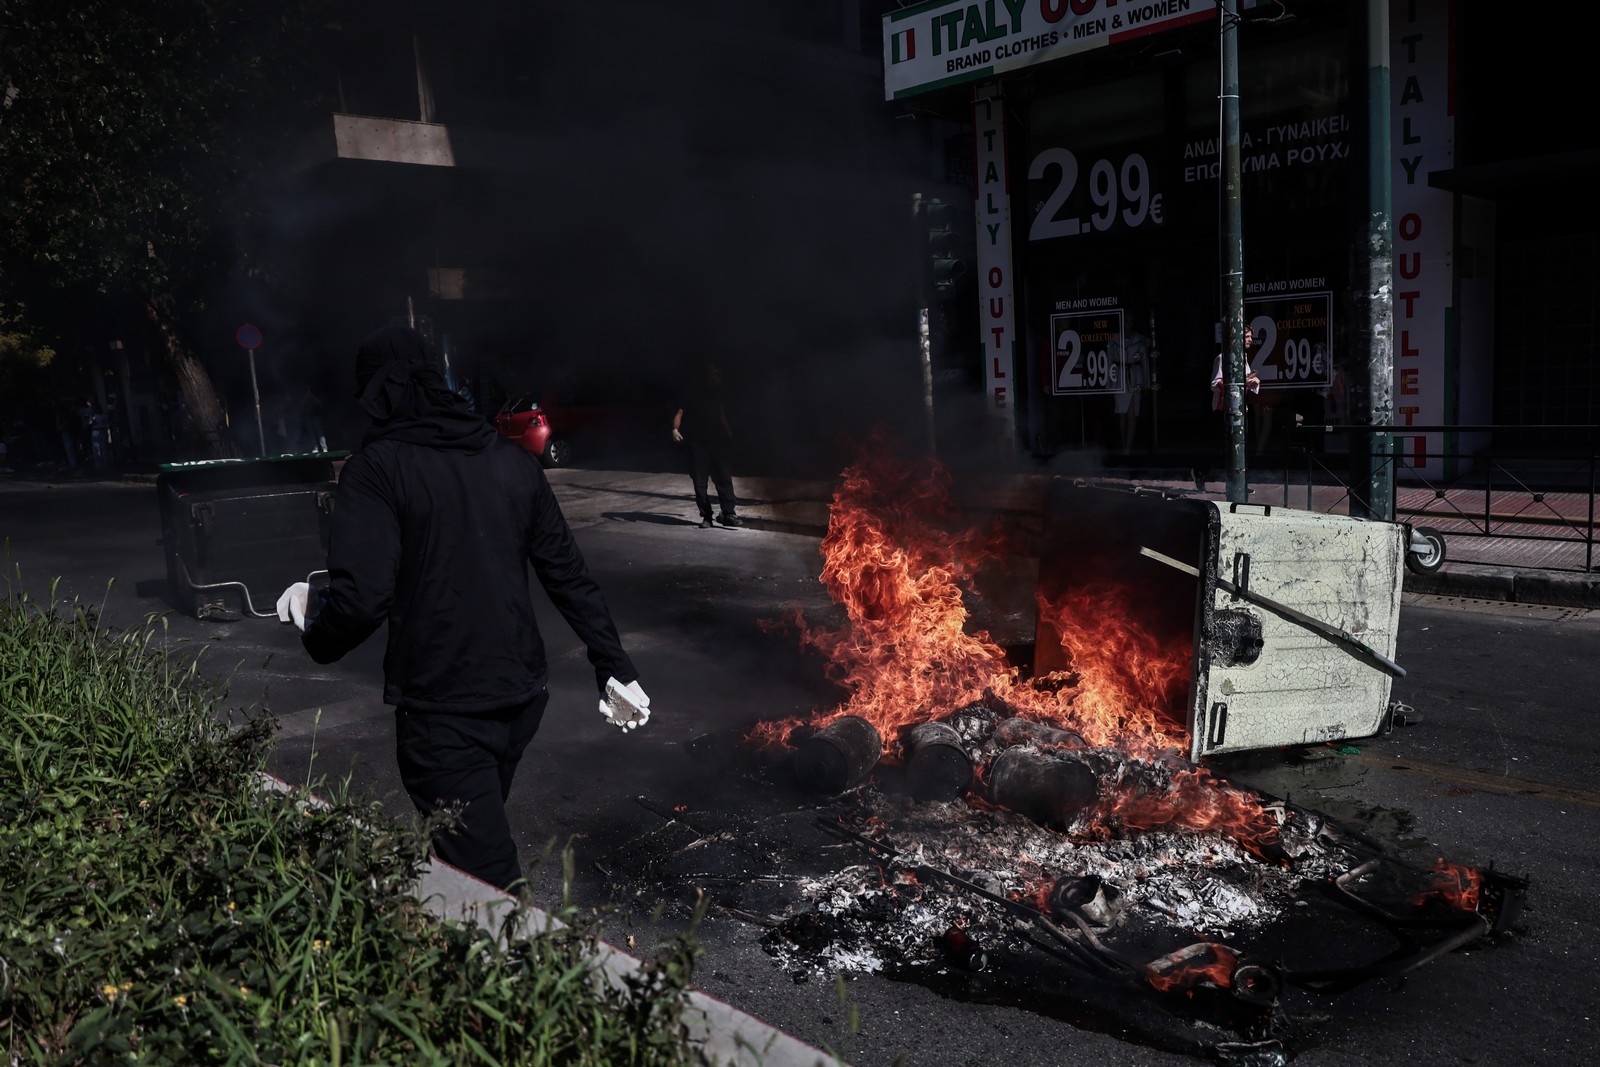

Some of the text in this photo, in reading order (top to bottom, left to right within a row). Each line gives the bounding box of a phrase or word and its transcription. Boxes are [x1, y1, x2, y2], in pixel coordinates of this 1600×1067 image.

[931, 0, 1026, 56] ITALY
[946, 50, 991, 73] BRAND
[995, 31, 1059, 59] CLOTHES
[1073, 18, 1106, 39] MEN
[1112, 14, 1123, 29] &
[1128, 0, 1190, 24] WOMEN
[1184, 132, 1253, 159] ΑΝΔΑ
[1184, 152, 1281, 183] ΕΠΩΥΜΑ
[1028, 147, 1163, 241] 2.99€
[1399, 0, 1423, 430] ITALY OUTLET
[984, 99, 1006, 409] ITALY OUTLE
[1055, 296, 1118, 310] MEN AND WOMEN
[1246, 277, 1326, 293] MEN AND WOMEN
[1093, 319, 1108, 329] NEW
[1277, 317, 1326, 330] COLLECTION
[1294, 303, 1312, 314] NEW
[1058, 329, 1118, 388] 2.99€
[1249, 315, 1322, 380] 2.99€
